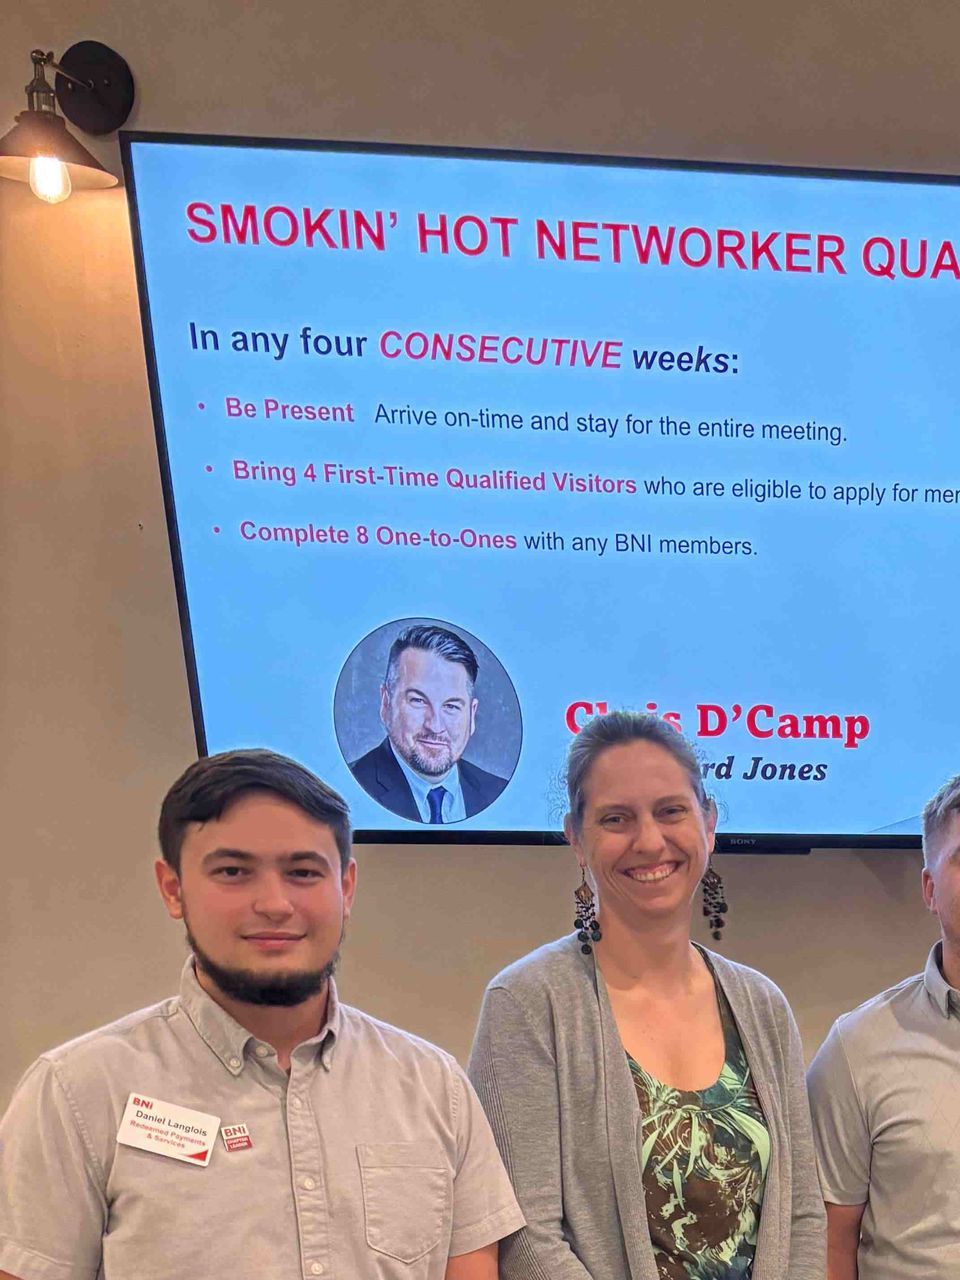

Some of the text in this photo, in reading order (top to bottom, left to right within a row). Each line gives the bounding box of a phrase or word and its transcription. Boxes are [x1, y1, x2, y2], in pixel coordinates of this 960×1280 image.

[187, 203, 397, 249] SMOKIN’
[418, 214, 517, 256] HOT
[537, 221, 845, 273] NETWORKER
[190, 322, 738, 373] In any four CONSECUTIVE weeks:
[226, 398, 846, 446] Be Present Arrive on-time and stay for the entire meeting.
[234, 461, 296, 486] Bring
[304, 464, 316, 482] 4
[324, 464, 438, 486] First-Time
[446, 469, 545, 490] Qualified
[553, 473, 637, 493] Visitors
[644, 477, 686, 495] who
[693, 482, 725, 497] are
[732, 479, 801, 502] eligible
[809, 482, 826, 500] to
[834, 483, 886, 506] apply
[893, 483, 918, 502] for
[241, 522, 757, 556] Complete 8 One-to-Ones with any BNI members.
[742, 757, 828, 782] Jones
[130, 1120, 206, 1146] Redeemed Payments
[136, 1110, 208, 1137] Daniel Langlois
[154, 1135, 186, 1149] Services
